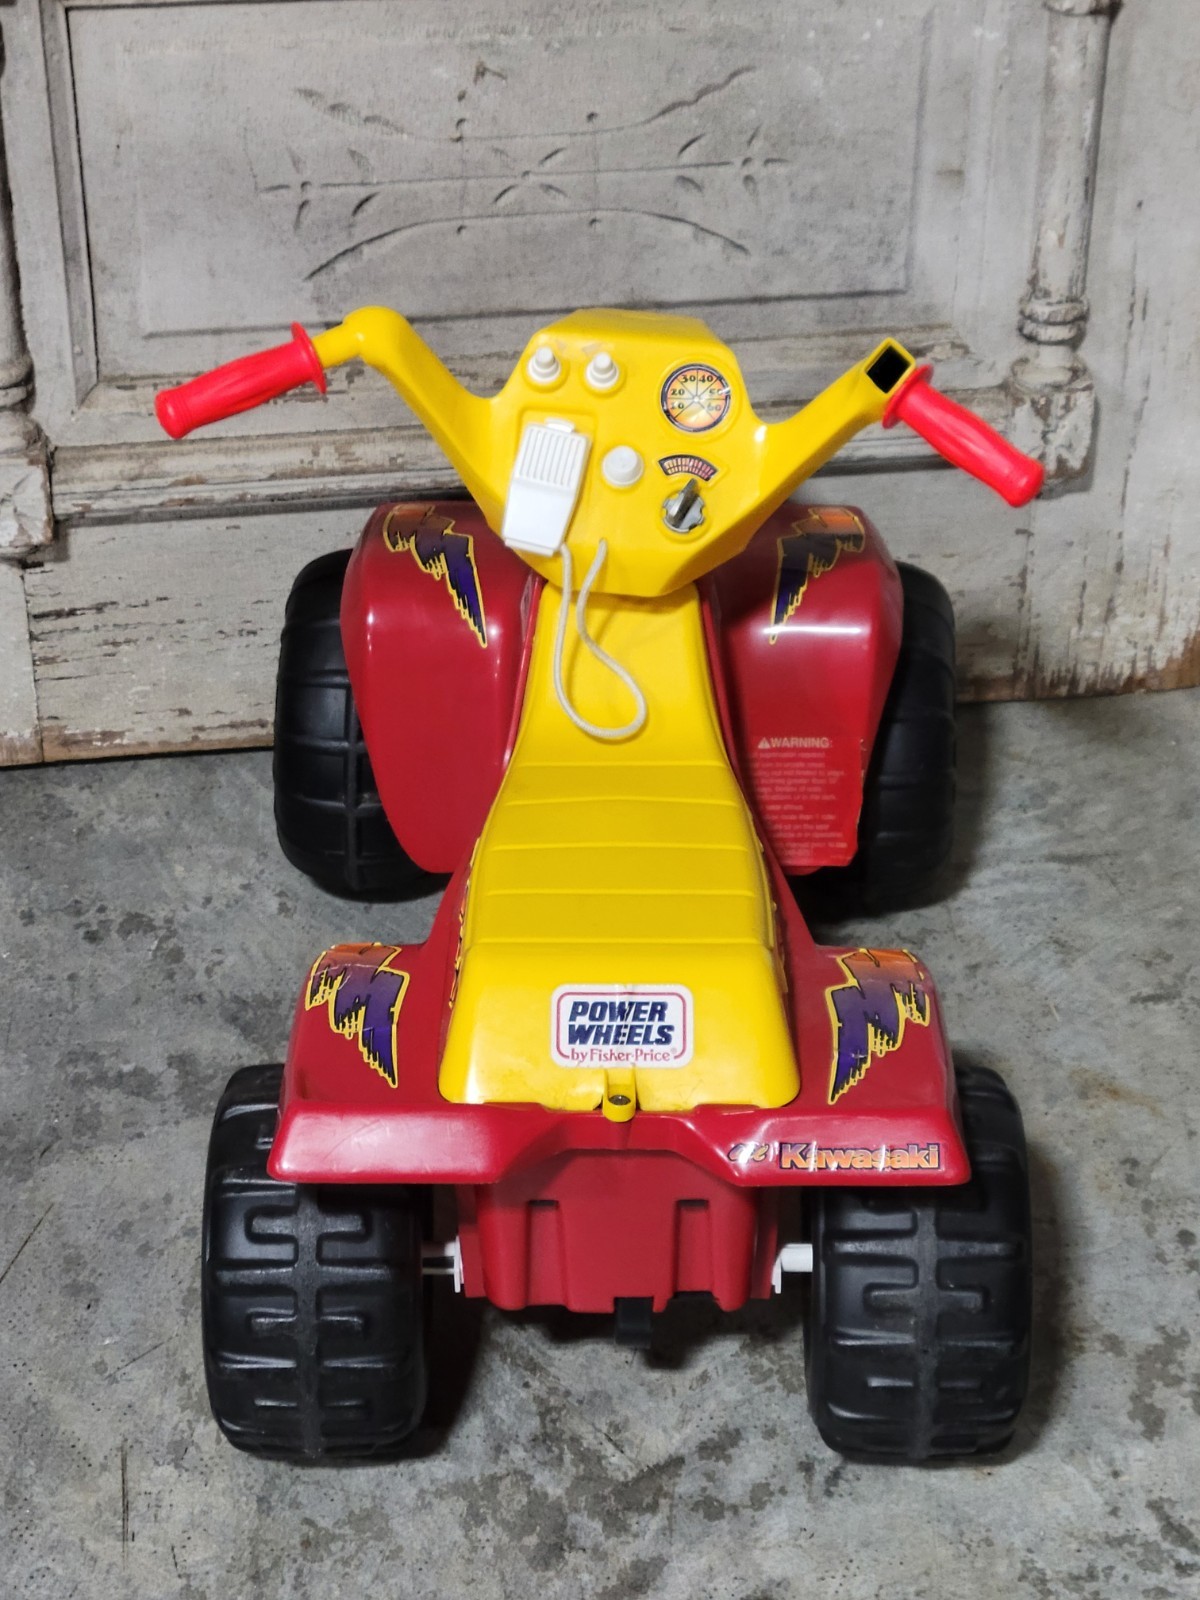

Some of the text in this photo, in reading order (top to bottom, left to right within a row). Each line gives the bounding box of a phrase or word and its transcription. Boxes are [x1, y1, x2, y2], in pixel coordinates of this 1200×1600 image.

[682, 374, 696, 383] 30
[699, 374, 714, 383] 40
[671, 388, 685, 396] 20
[568, 1001, 668, 1022] POWER
[568, 1024, 675, 1045] WHEELS
[571, 1048, 587, 1062] by
[779, 1142, 940, 1169] Kawasaki
